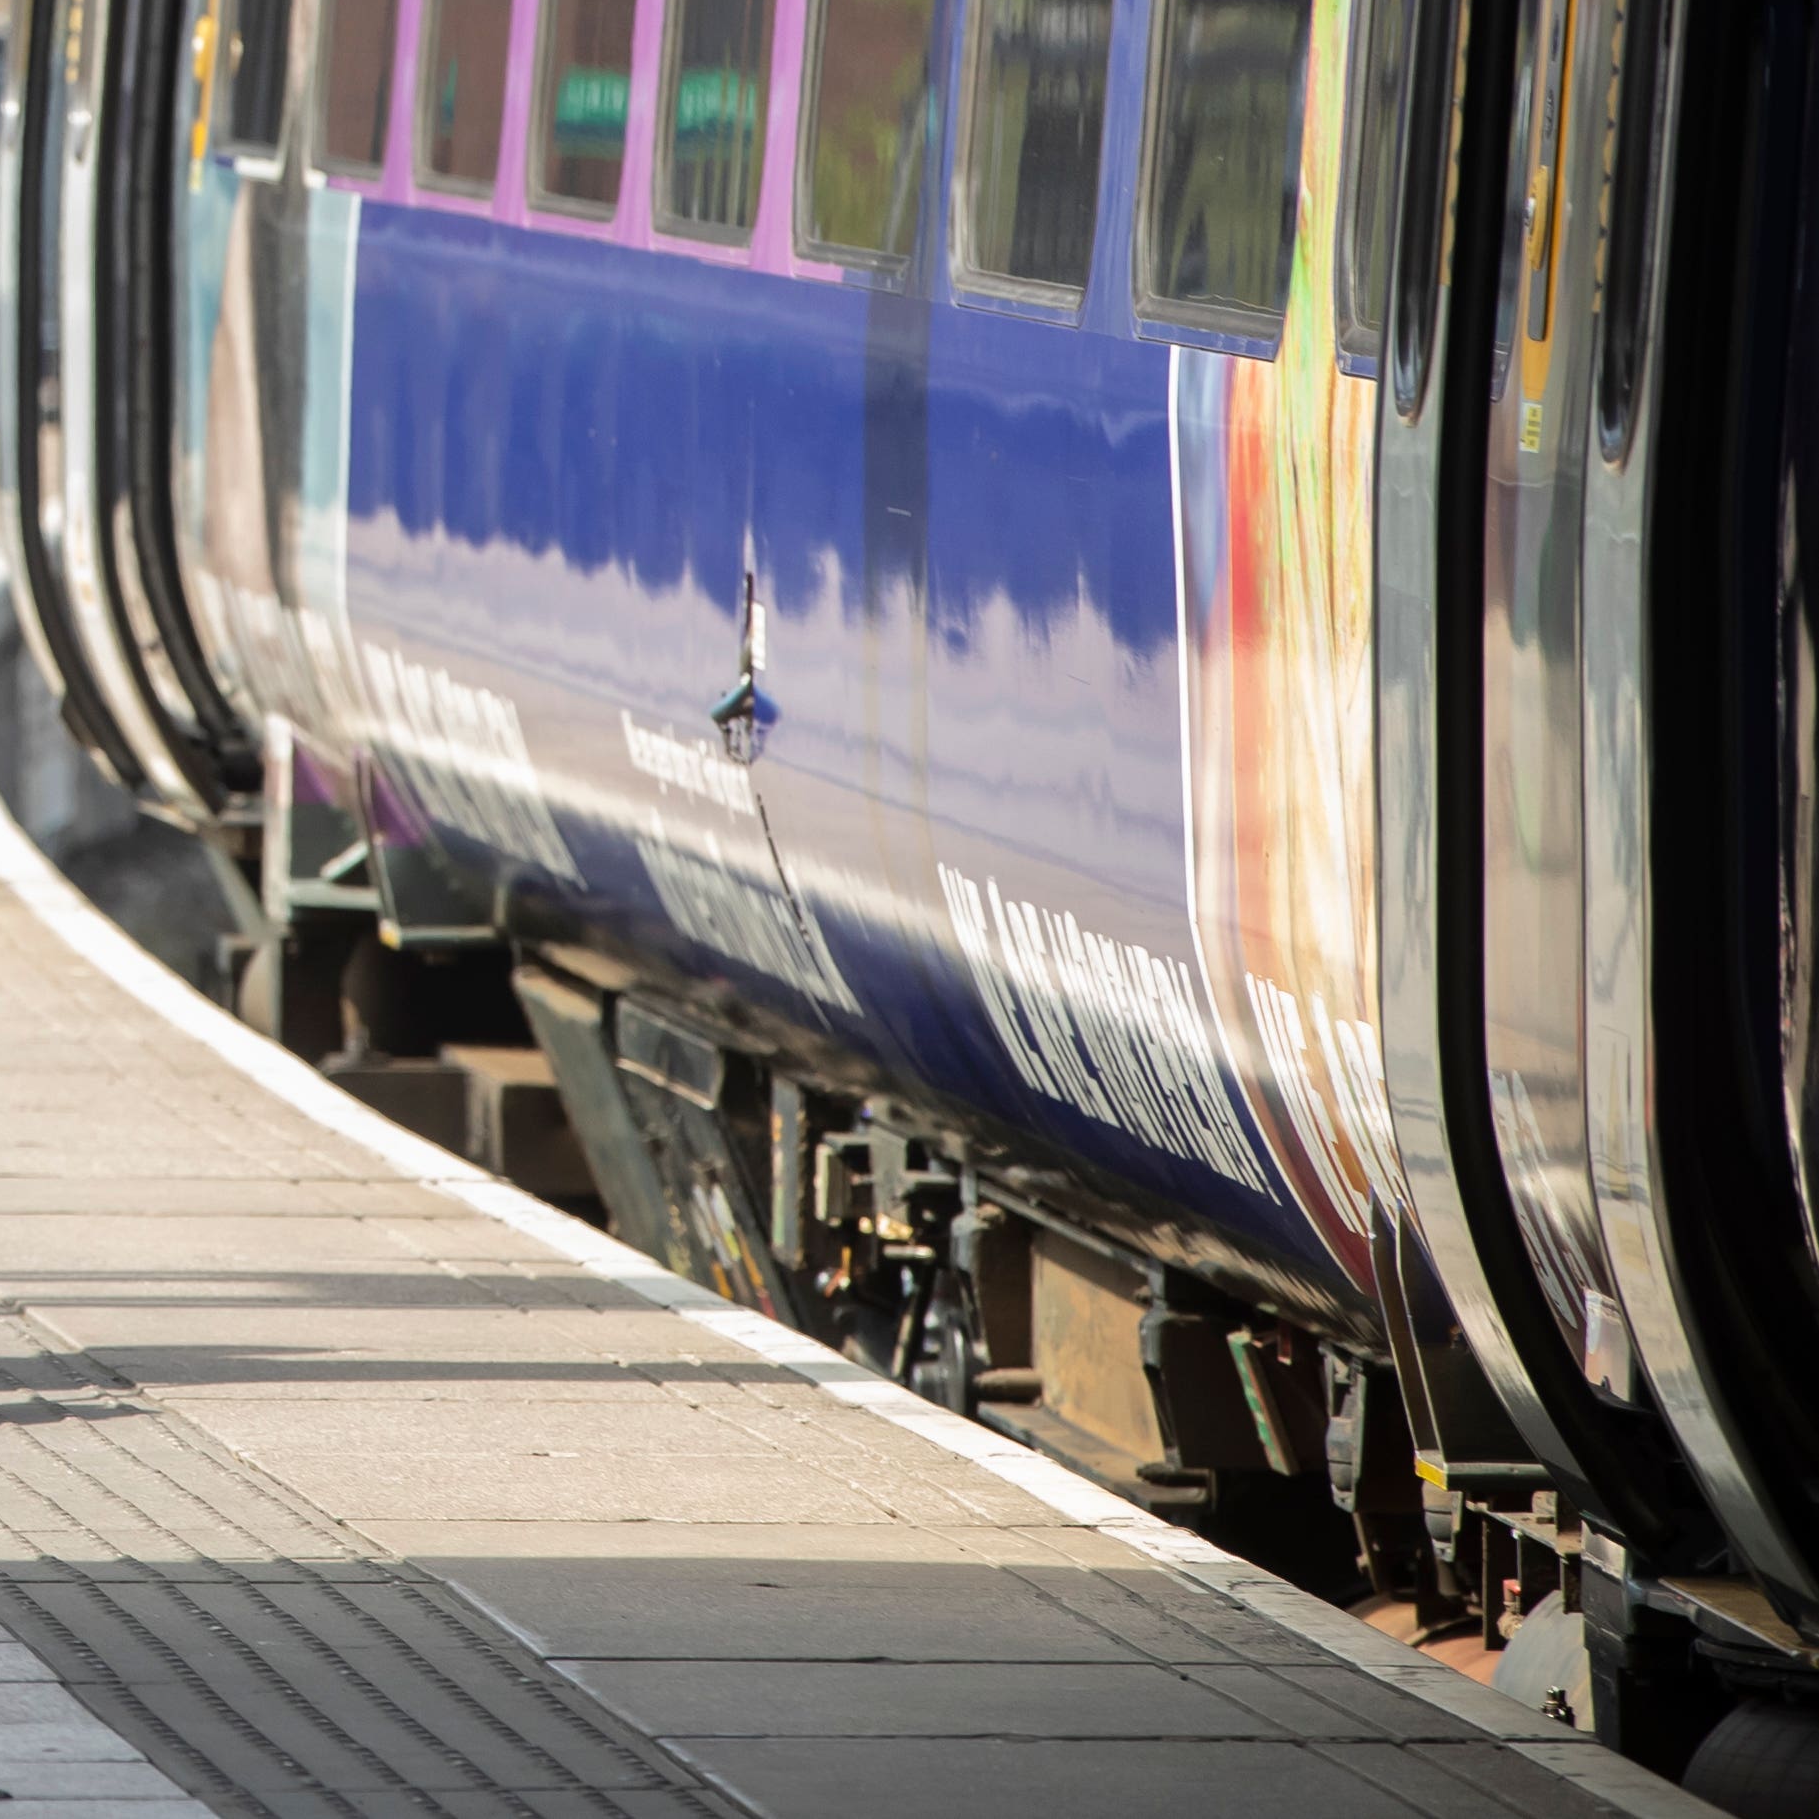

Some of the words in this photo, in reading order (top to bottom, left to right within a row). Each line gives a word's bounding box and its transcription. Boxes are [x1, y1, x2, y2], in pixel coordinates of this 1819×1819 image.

[937, 862, 1068, 1104] WE
[986, 875, 1128, 1131] ARE
[1041, 907, 1284, 1206] NORTHERN
